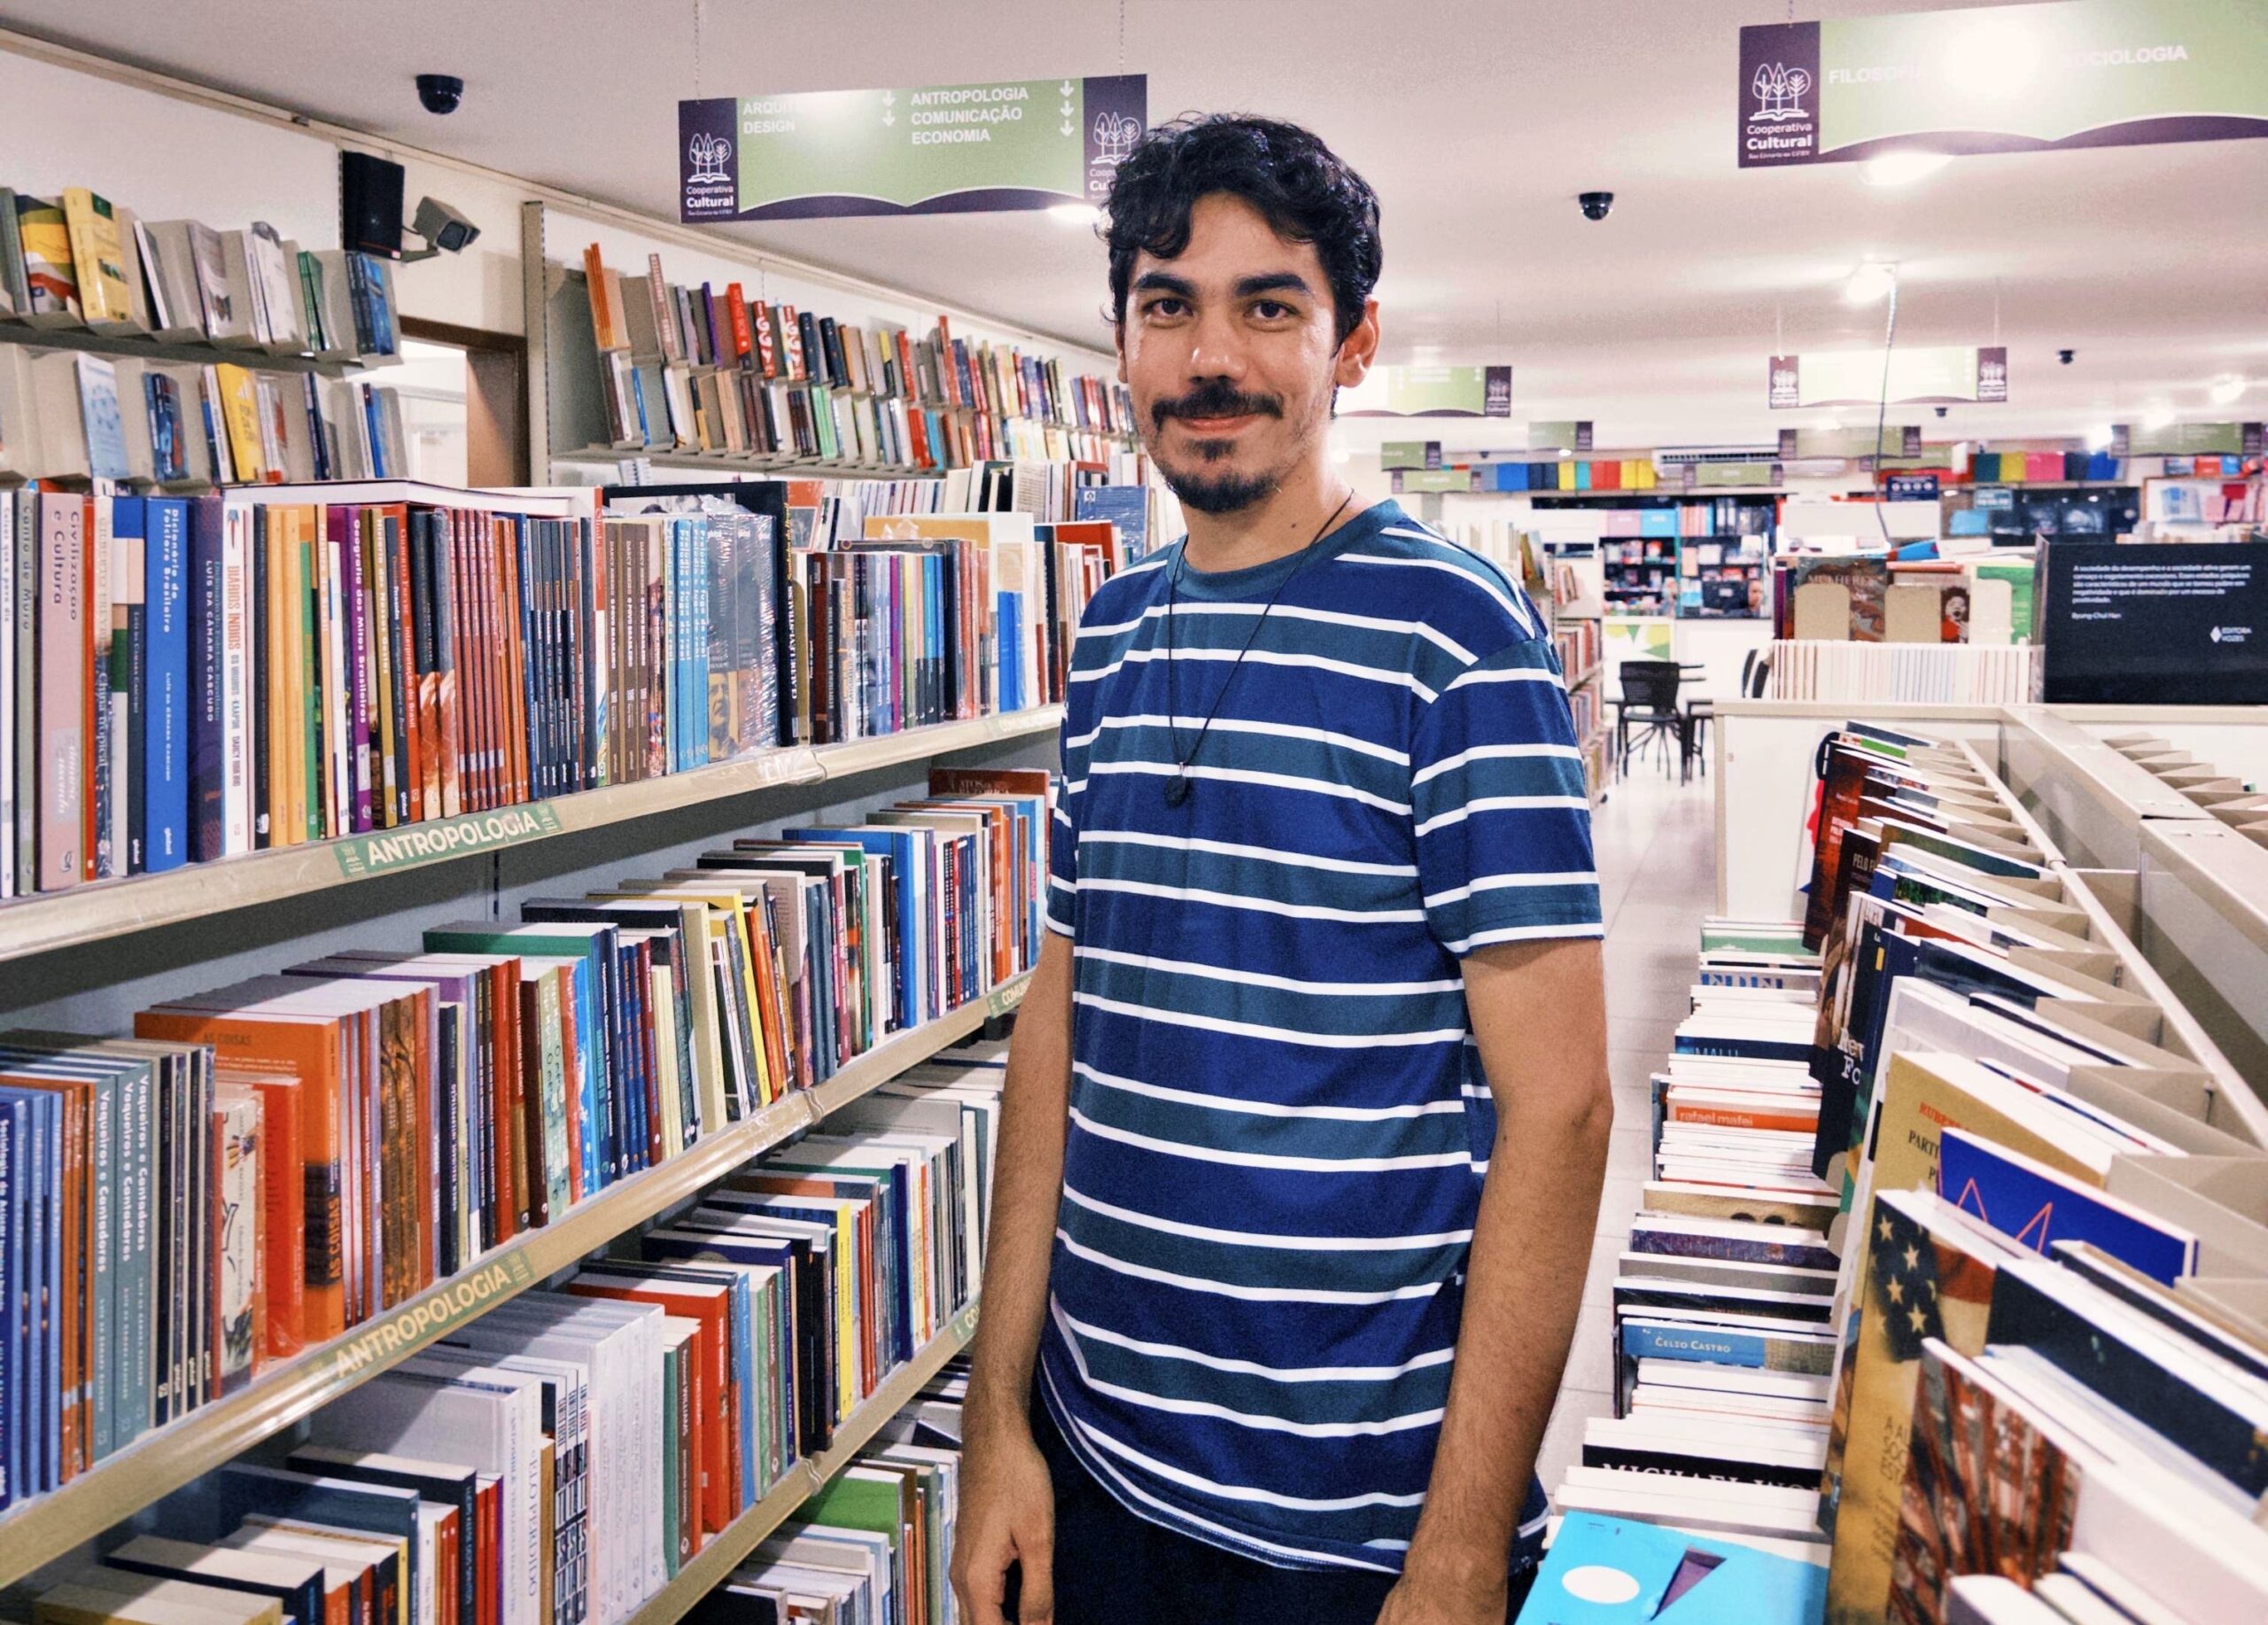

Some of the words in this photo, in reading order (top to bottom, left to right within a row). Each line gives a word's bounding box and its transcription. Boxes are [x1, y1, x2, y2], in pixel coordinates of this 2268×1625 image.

[911, 87, 1029, 105] ANTROPOLOGIA
[911, 105, 1022, 127] COMUNICAÇÃO
[742, 119, 796, 135] DESIGN
[912, 128, 991, 145] ECONOMIA
[1746, 123, 1813, 135] Cooperativa
[1746, 134, 1813, 150] Cultural
[687, 185, 734, 195] Cooperativa
[687, 196, 734, 207] Cultural
[22, 506, 33, 552] Canto
[53, 510, 65, 520] e
[163, 509, 172, 560] Folclore
[171, 509, 180, 576] Dicionário
[353, 519, 362, 585] Geografia
[22, 562, 33, 580] de
[53, 531, 65, 604] Cultura
[68, 510, 81, 621] Civilização
[206, 560, 214, 584] LUÍS
[163, 567, 172, 633] Brasileiro
[171, 583, 180, 598] do
[206, 591, 214, 606] DA
[227, 565, 242, 610] DIÁRIOS
[355, 590, 364, 611] dos
[22, 588, 33, 630] Muro
[786, 586, 797, 657] LÉVI-STRAUSS
[206, 610, 214, 660] CÂMARA
[227, 612, 242, 649] ÍNDIOS
[356, 616, 365, 650] Mitos
[206, 665, 214, 722] CASCUDO
[358, 657, 367, 724] Brasileiros
[788, 659, 797, 699] CLAUDE
[163, 828, 172, 855] global
[368, 811, 540, 866] ANTROPOLOGIA
[97, 1089, 111, 1168] Vaqueiros
[121, 1082, 135, 1156] Vaqueiros
[136, 1075, 149, 1148] Vaqueiros
[1680, 1109, 1715, 1123] rafael
[1717, 1114, 1753, 1126] mafei
[97, 1186, 110, 1272] Cantadores
[122, 1176, 134, 1261] Cantadores
[136, 1167, 148, 1251] Cantadores
[327, 1198, 341, 1253] COISAS
[328, 1255, 342, 1279] AS
[337, 1264, 511, 1379] ANTROPOLOGIA
[1654, 1335, 1688, 1349] CELSO
[1690, 1340, 1731, 1354] CASTRO
